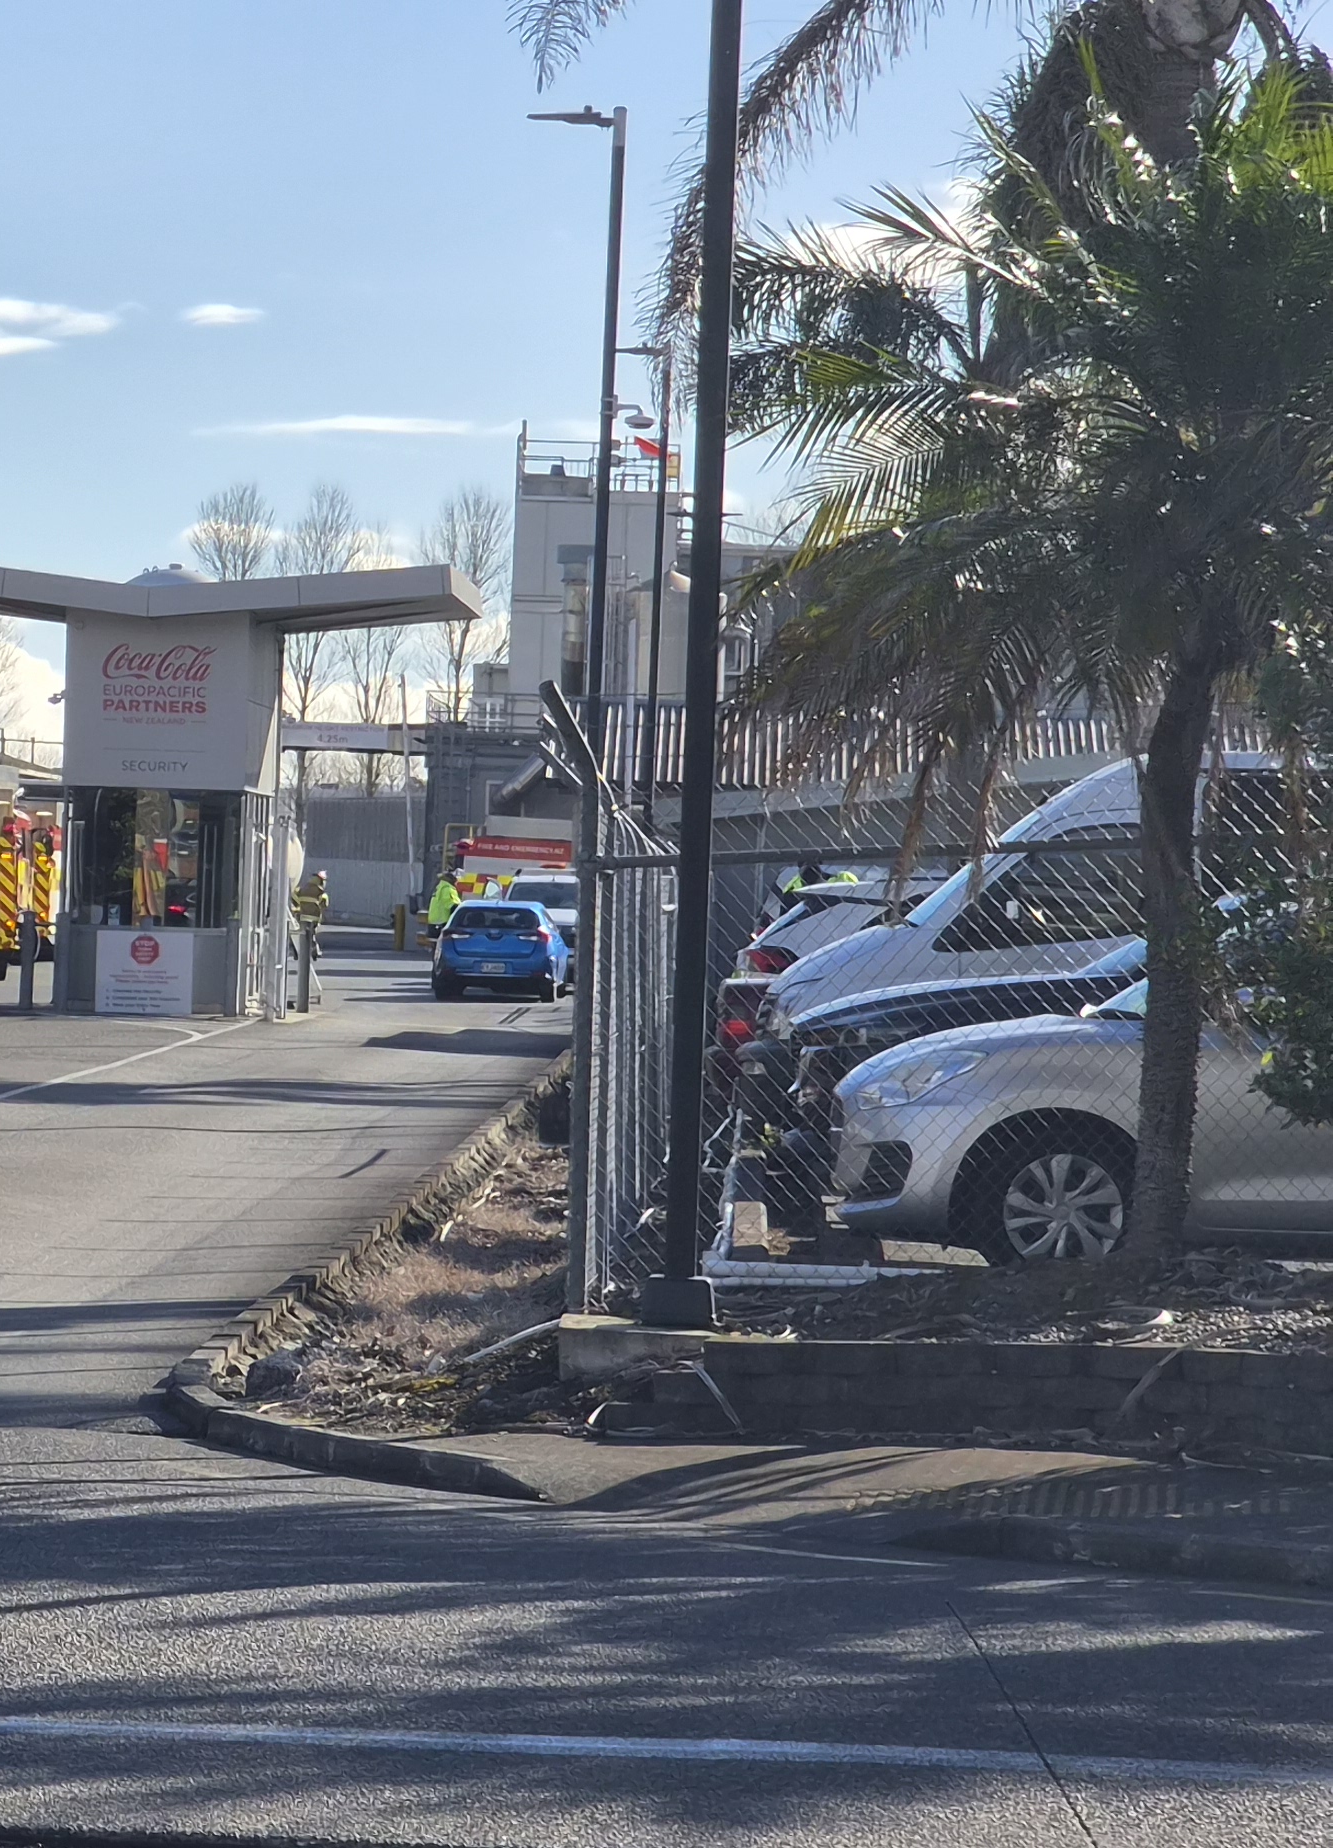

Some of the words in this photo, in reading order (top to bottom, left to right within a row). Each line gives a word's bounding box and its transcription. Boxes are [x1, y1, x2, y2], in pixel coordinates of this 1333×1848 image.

[102, 684, 207, 699] EUROPACIFIC
[102, 699, 207, 714] PARTNERS
[122, 717, 143, 725] NEW
[145, 717, 186, 726] ZEALAND
[316, 733, 349, 744] 4.25m
[121, 760, 189, 773] SECURITY
